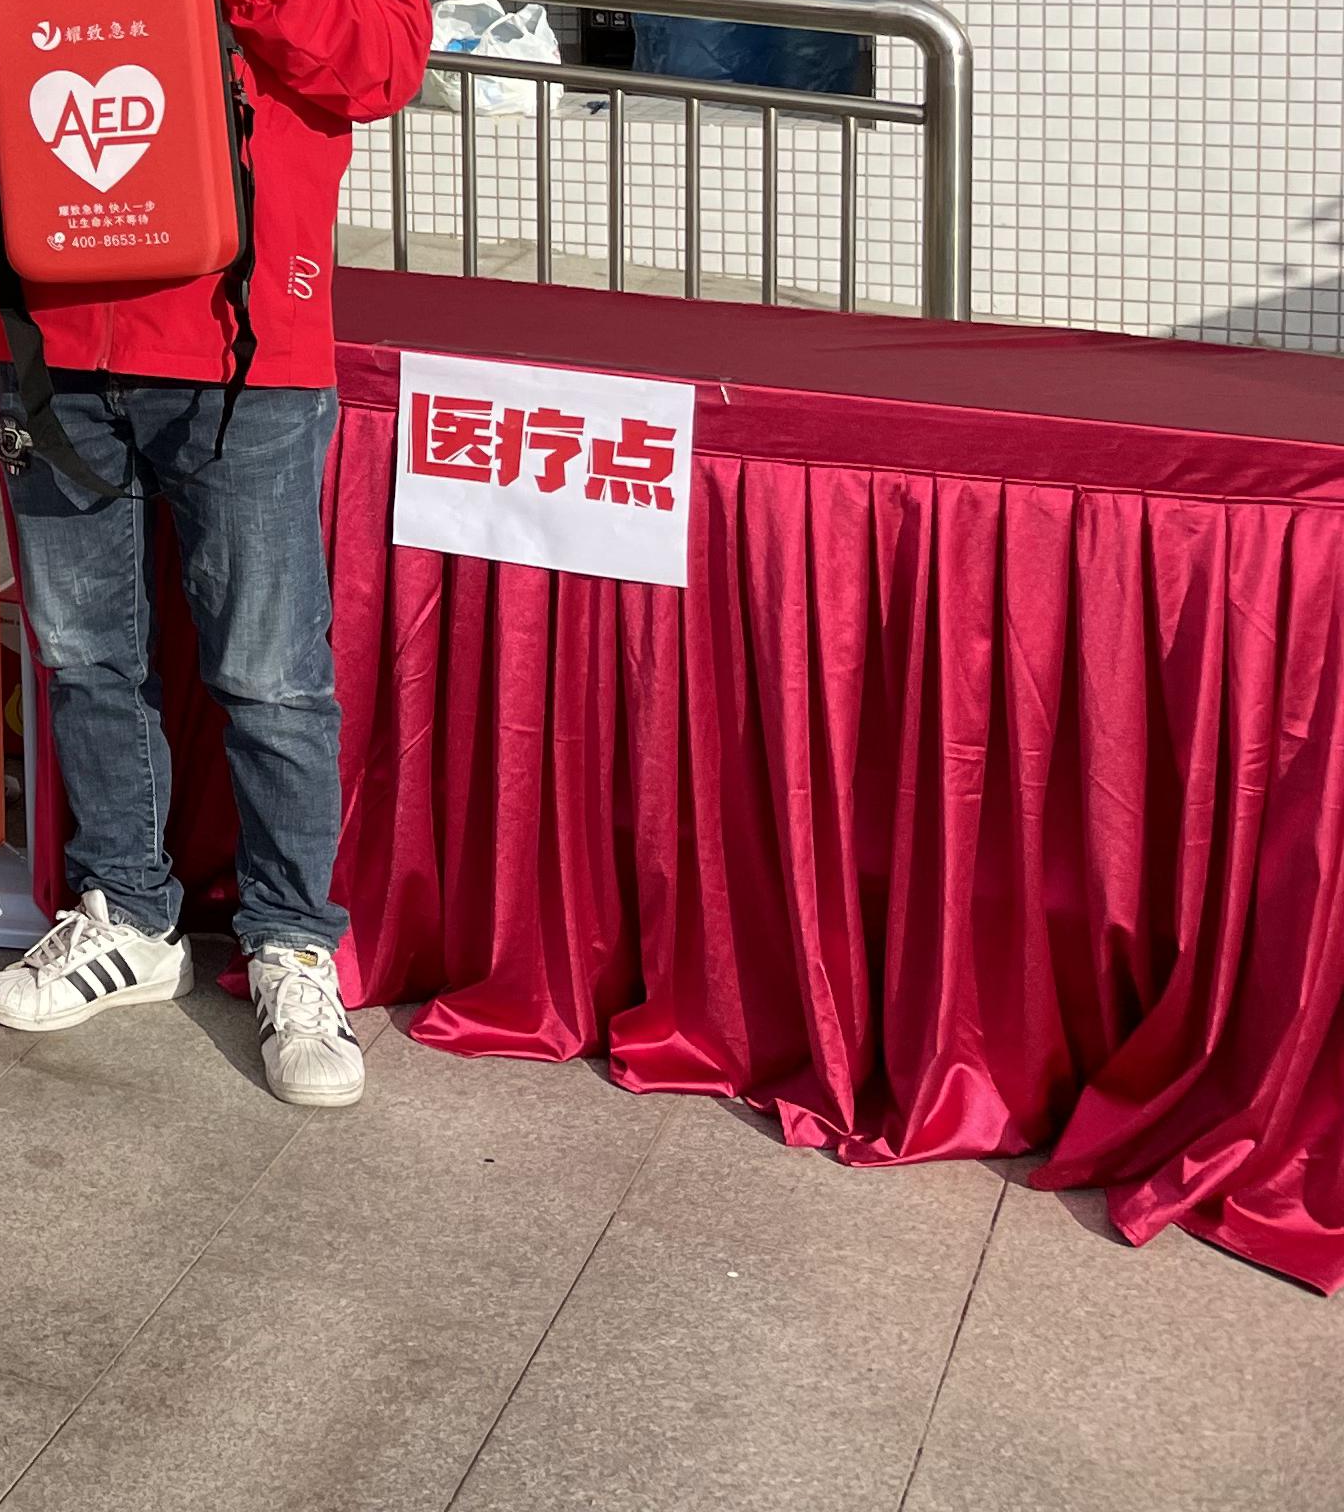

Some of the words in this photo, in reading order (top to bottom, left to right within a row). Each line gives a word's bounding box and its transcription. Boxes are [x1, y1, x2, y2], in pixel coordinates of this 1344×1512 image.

[65, 19, 150, 44] 耀致急救
[57, 89, 155, 136] AED
[71, 231, 170, 248] 400-8653-110
[407, 392, 678, 511] 医疗点
